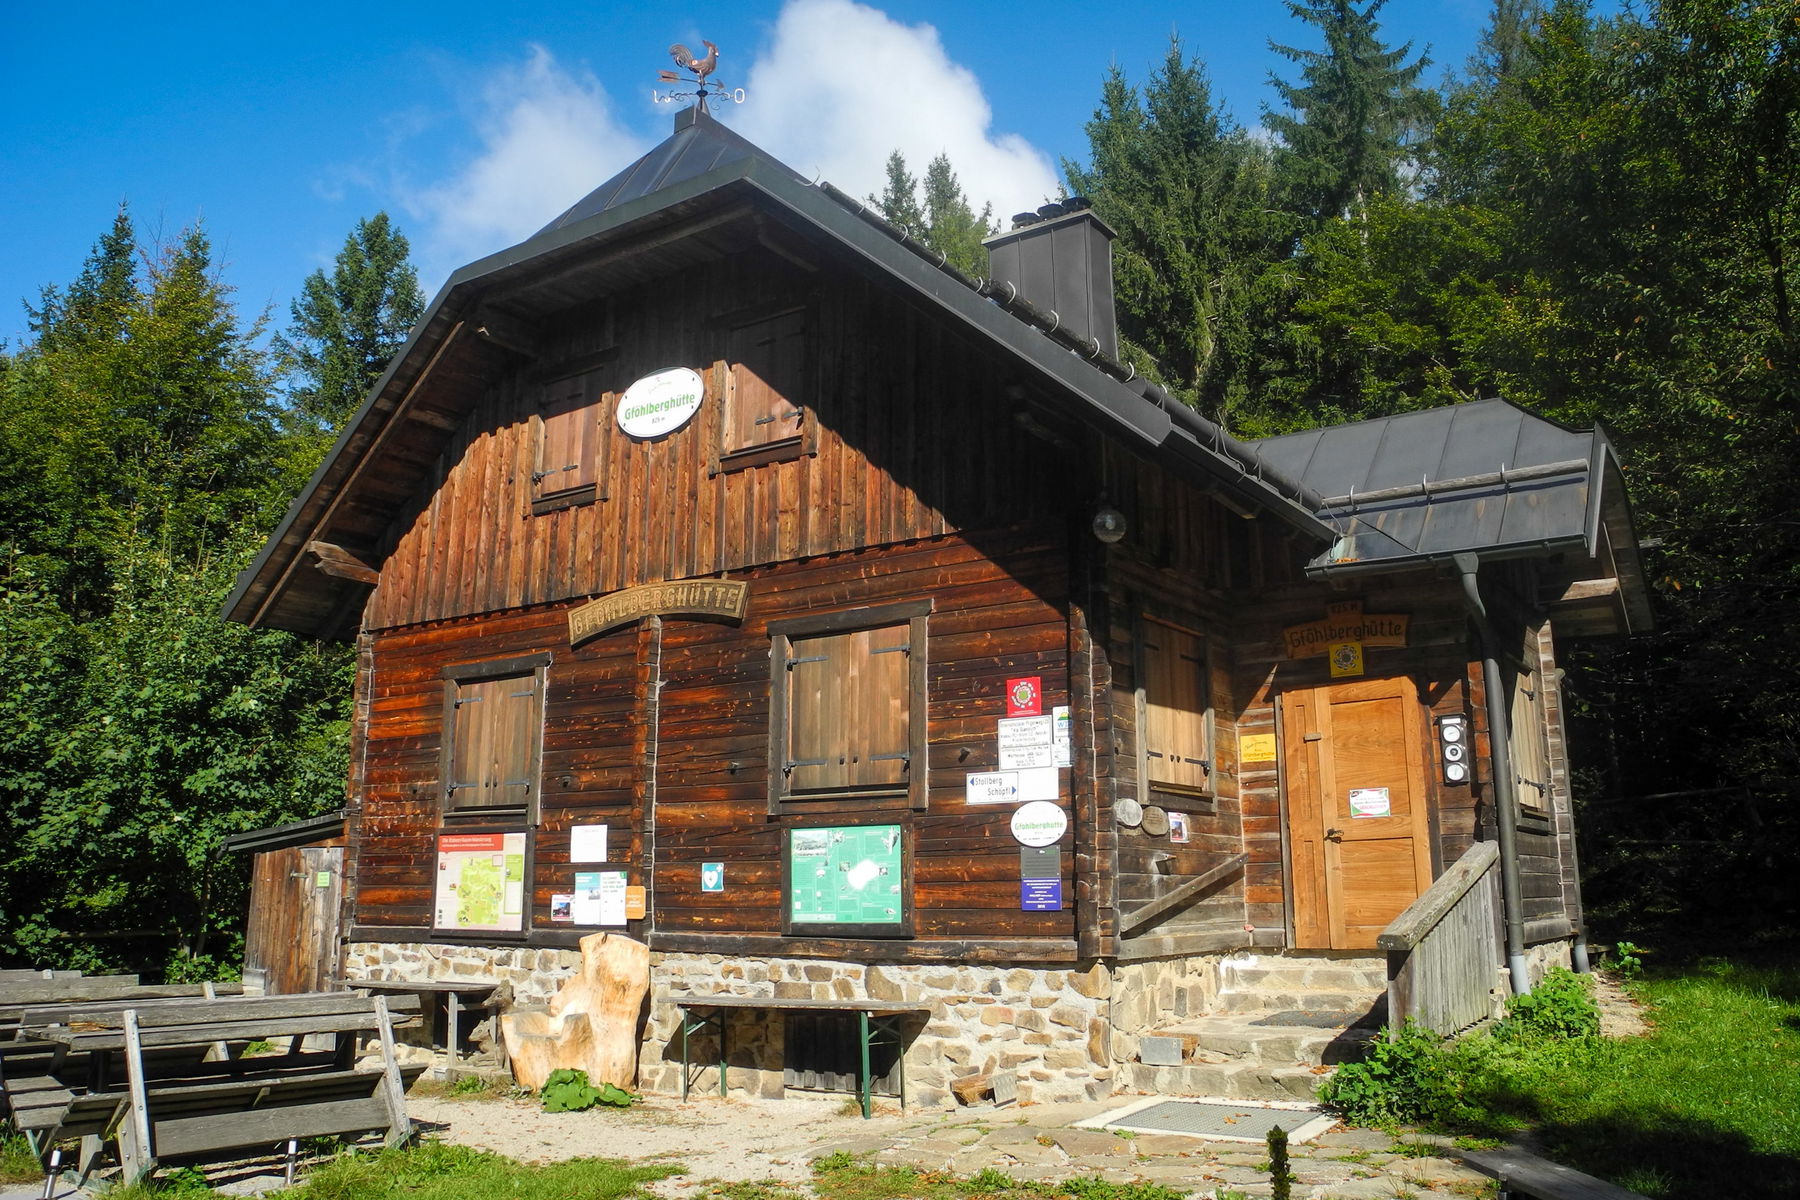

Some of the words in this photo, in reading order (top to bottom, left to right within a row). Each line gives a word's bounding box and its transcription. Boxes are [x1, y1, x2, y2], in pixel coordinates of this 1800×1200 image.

[624, 393, 696, 420] Gföhlberghütte
[573, 582, 739, 635] GFÖHLBERGHÜTTE
[1289, 619, 1402, 648] Gföhlberghütte
[975, 776, 1003, 787] Stollberg
